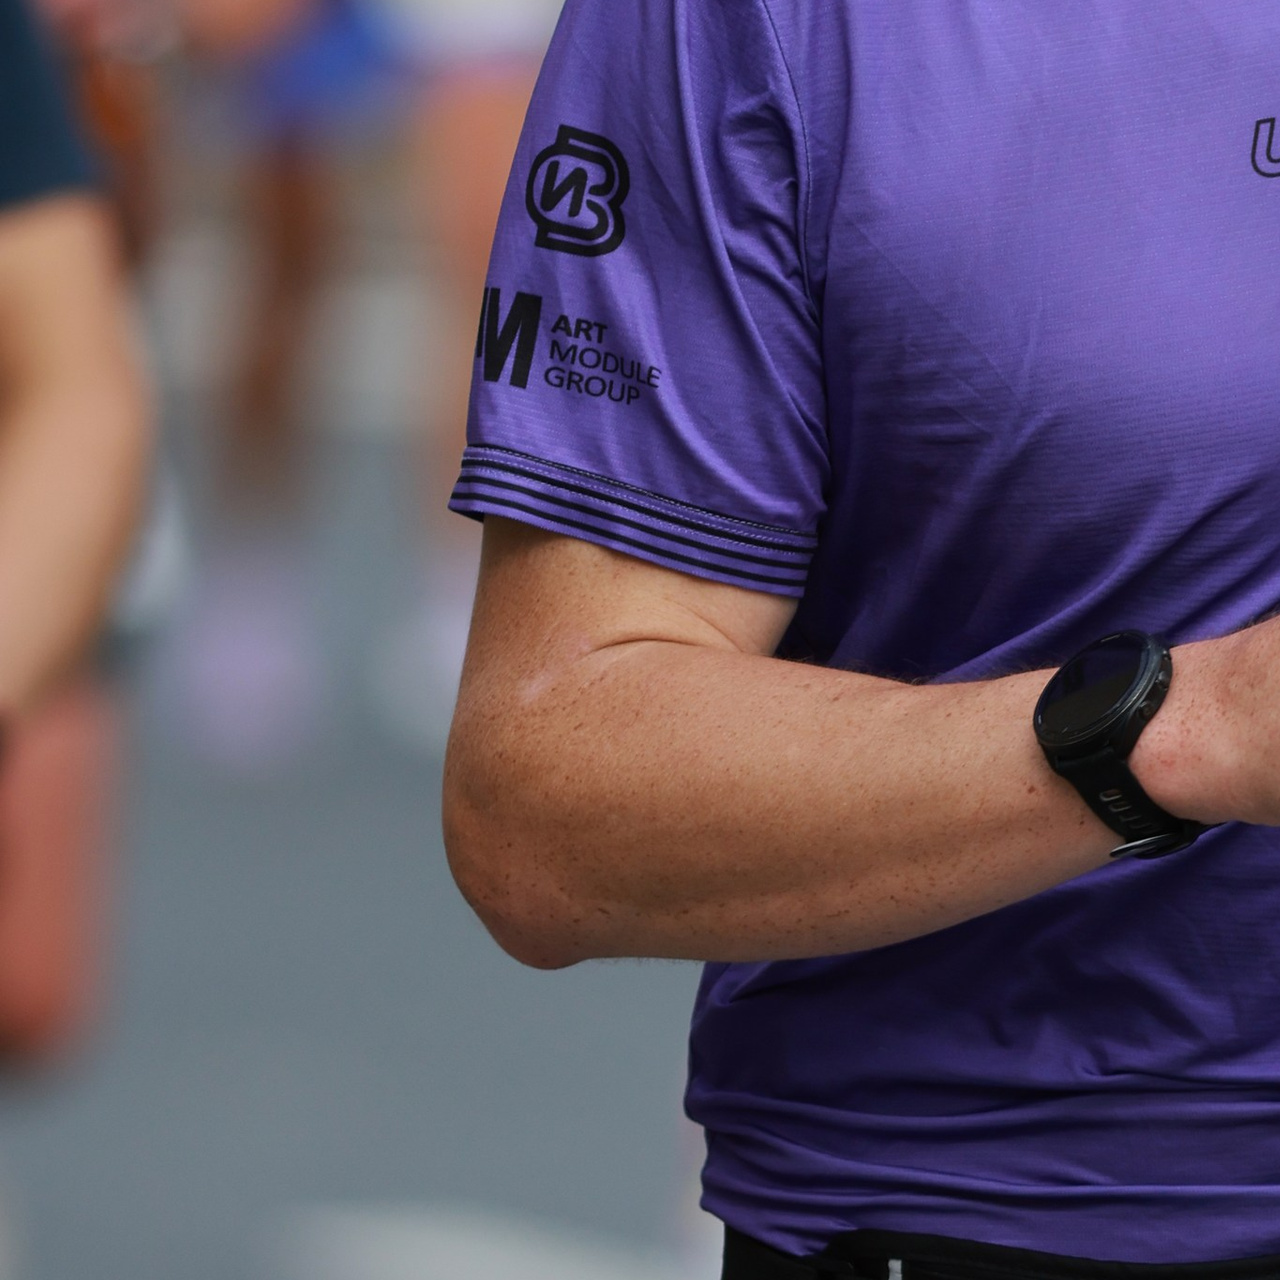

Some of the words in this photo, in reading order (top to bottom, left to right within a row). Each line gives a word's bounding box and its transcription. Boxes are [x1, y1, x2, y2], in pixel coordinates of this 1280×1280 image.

[551, 314, 608, 343] ART
[549, 339, 662, 388] MODULE
[544, 366, 640, 405] GROUP
